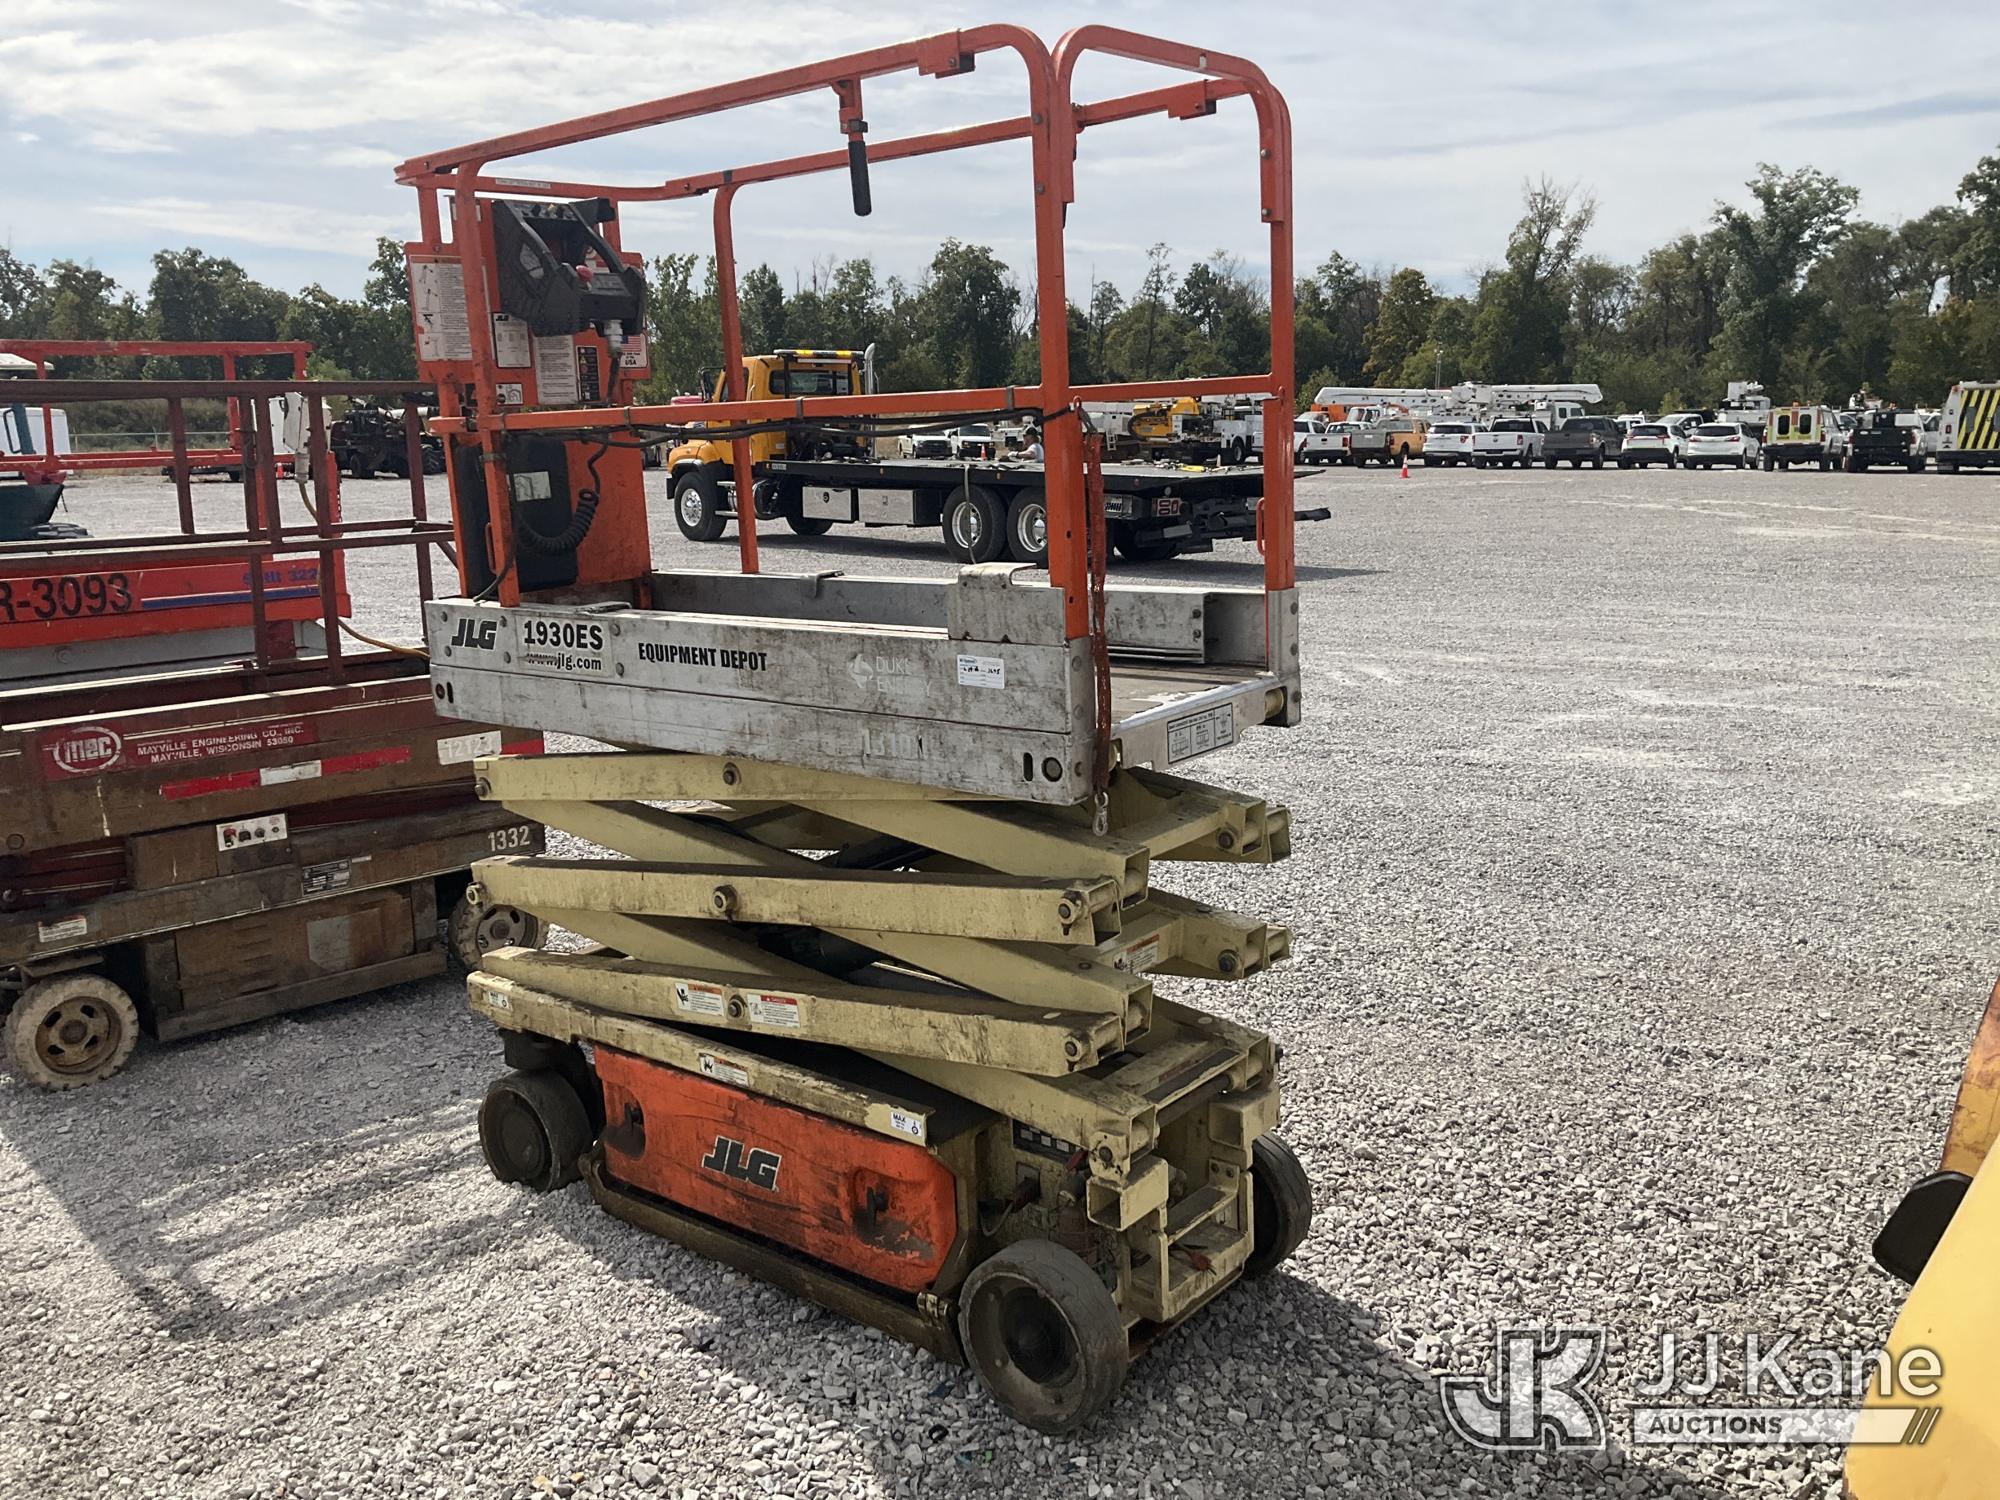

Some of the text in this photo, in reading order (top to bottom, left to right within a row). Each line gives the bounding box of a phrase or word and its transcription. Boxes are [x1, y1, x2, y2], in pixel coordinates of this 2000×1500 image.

[451, 618, 498, 650] JLG
[524, 620, 603, 651] 1930ES
[638, 642, 768, 672] EQUIPMENT DEPOT
[137, 740, 187, 756] MAYVILLE
[192, 732, 258, 748] ENGINEERING
[206, 741, 261, 755] WISCONSIN
[488, 825, 530, 852] 1332
[701, 1135, 781, 1192] JLG
